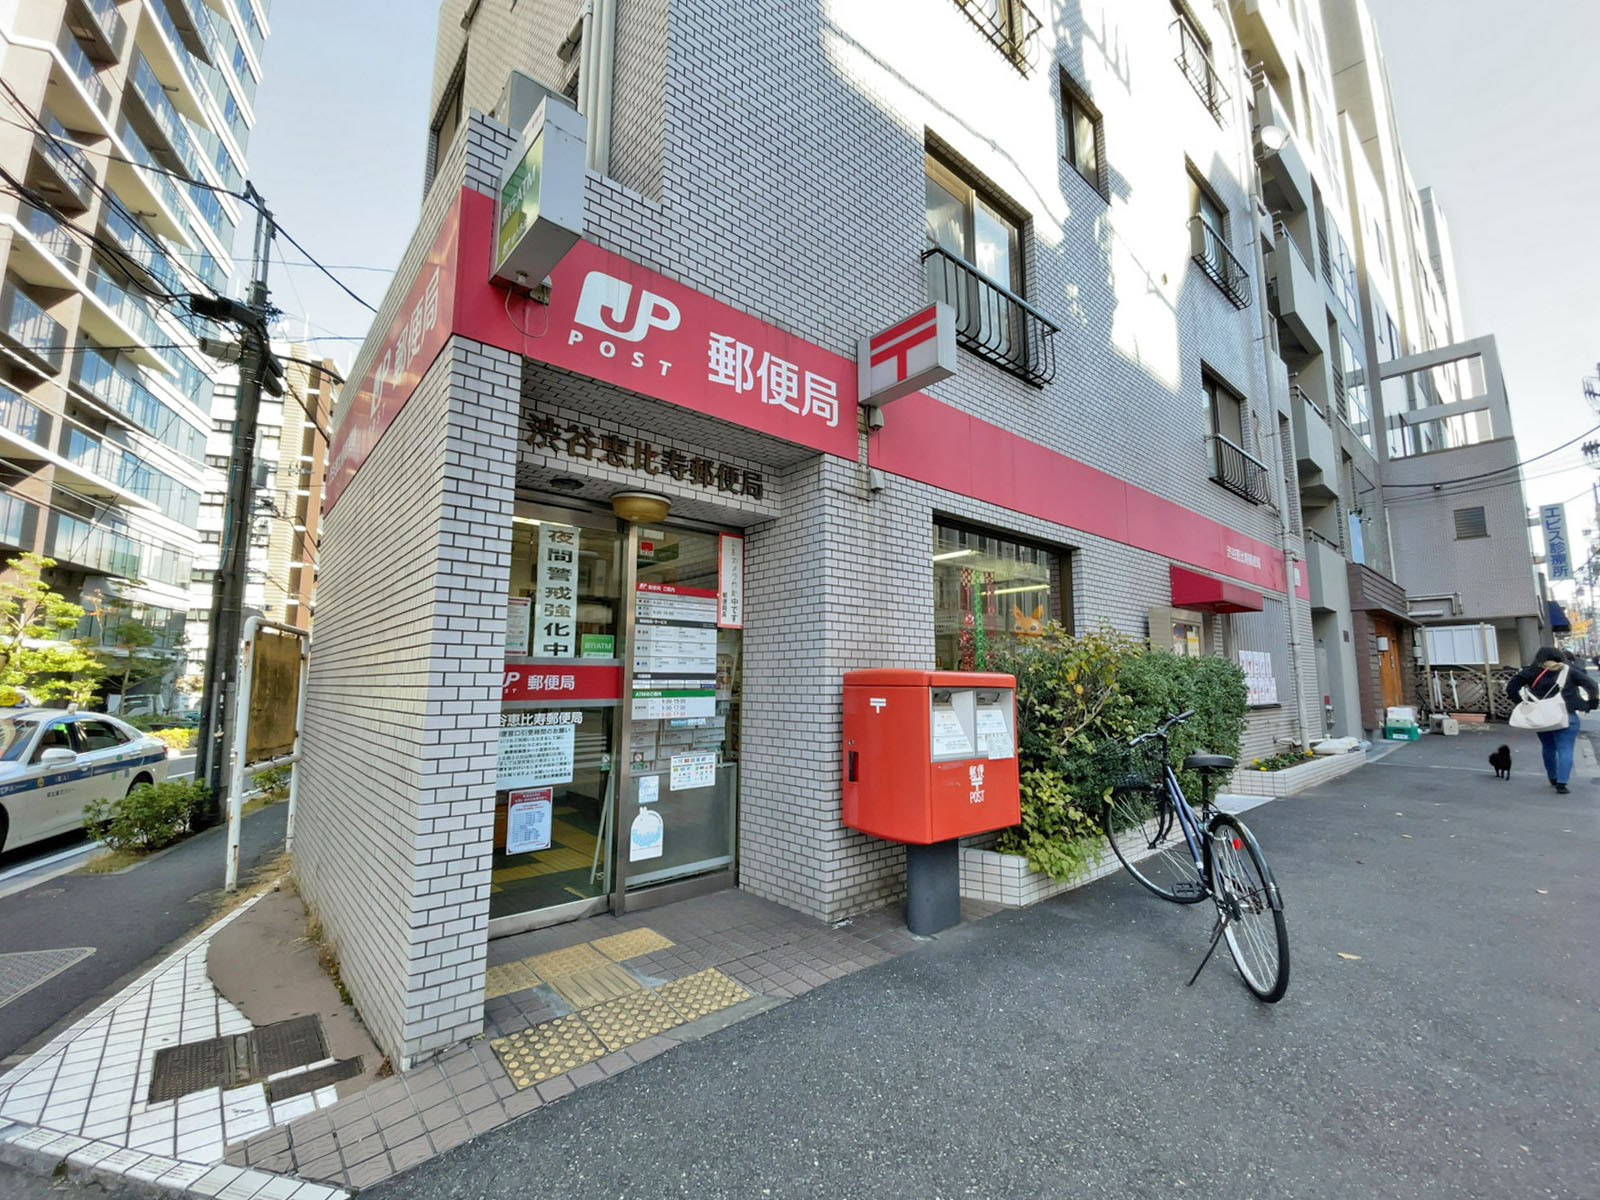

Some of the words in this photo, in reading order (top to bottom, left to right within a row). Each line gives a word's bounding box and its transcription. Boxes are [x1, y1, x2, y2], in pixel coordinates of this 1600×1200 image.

[392, 266, 440, 390] 郵便局
[574, 271, 681, 342] JP
[567, 329, 673, 377] POST
[707, 331, 839, 428] 郵便局
[526, 413, 764, 500] 渋谷恵比寿郵便局
[1545, 507, 1568, 577] エビス診療所
[543, 530, 574, 656] 夜間警戒強化中
[527, 674, 575, 691] 郵便局
[969, 790, 984, 804] POST
